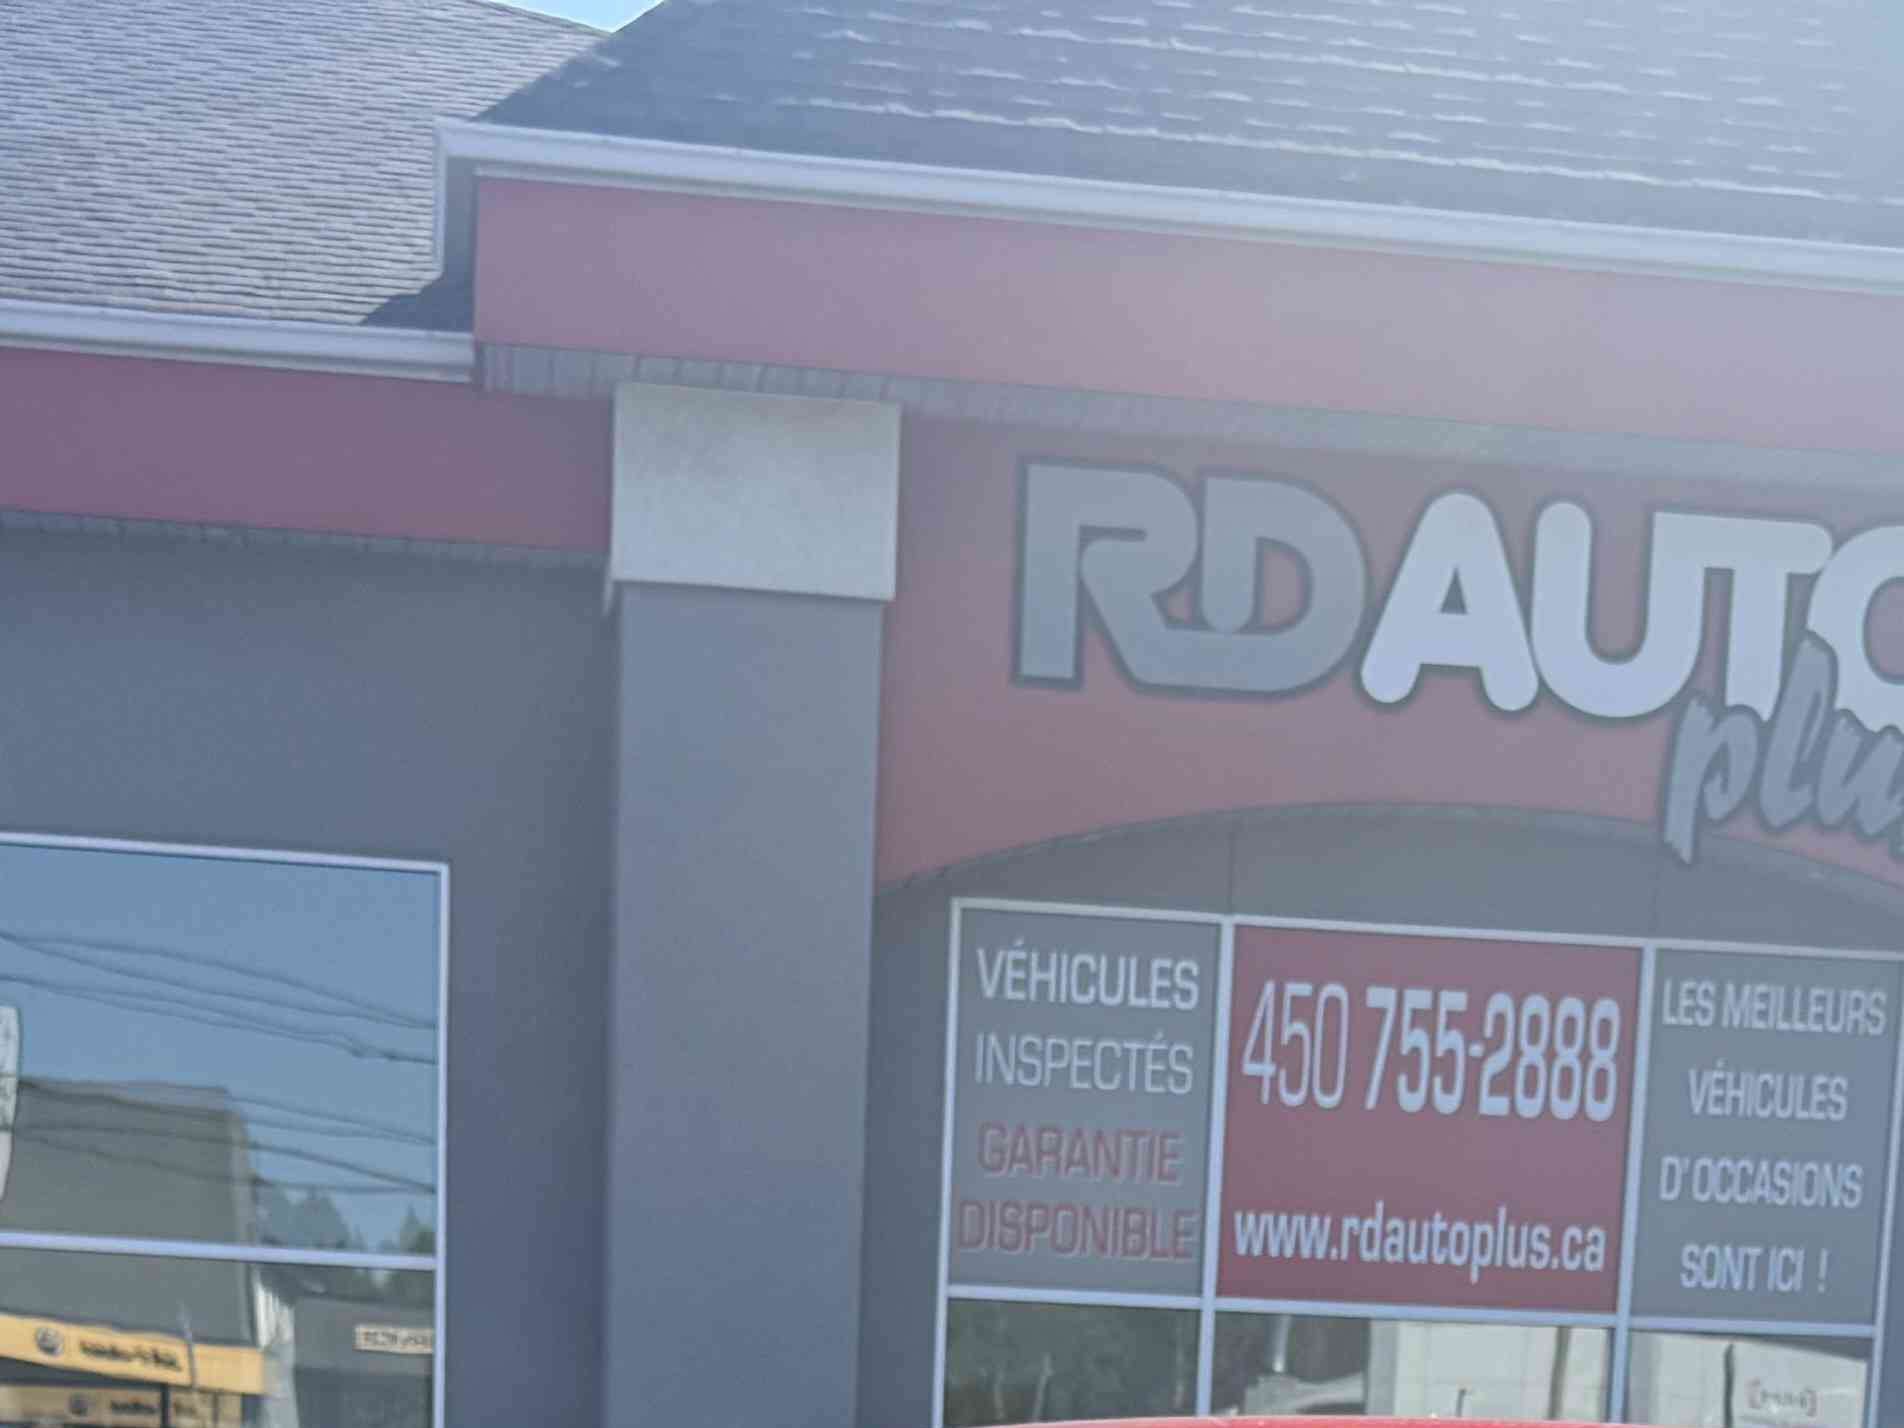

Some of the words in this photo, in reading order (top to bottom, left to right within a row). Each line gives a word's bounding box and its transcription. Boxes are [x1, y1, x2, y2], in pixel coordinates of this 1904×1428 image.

[976, 936, 1200, 1010] VÉHICULES
[1662, 977, 1716, 1028] LES
[1720, 982, 1887, 1036] MEILLEURS
[975, 1030, 1194, 1095] INSPECTÉS
[1241, 979, 1350, 1109] 450
[1364, 985, 1622, 1122] 755-2888
[1688, 1057, 1849, 1122] VÉHICULES
[977, 1120, 1185, 1187] GARANTIE
[957, 1198, 1201, 1263] DISPONIBLE
[1233, 1199, 1607, 1285] www.rdautoplus.ca
[1679, 1243, 1764, 1291] SONT
[1766, 1247, 1805, 1292] ICI
